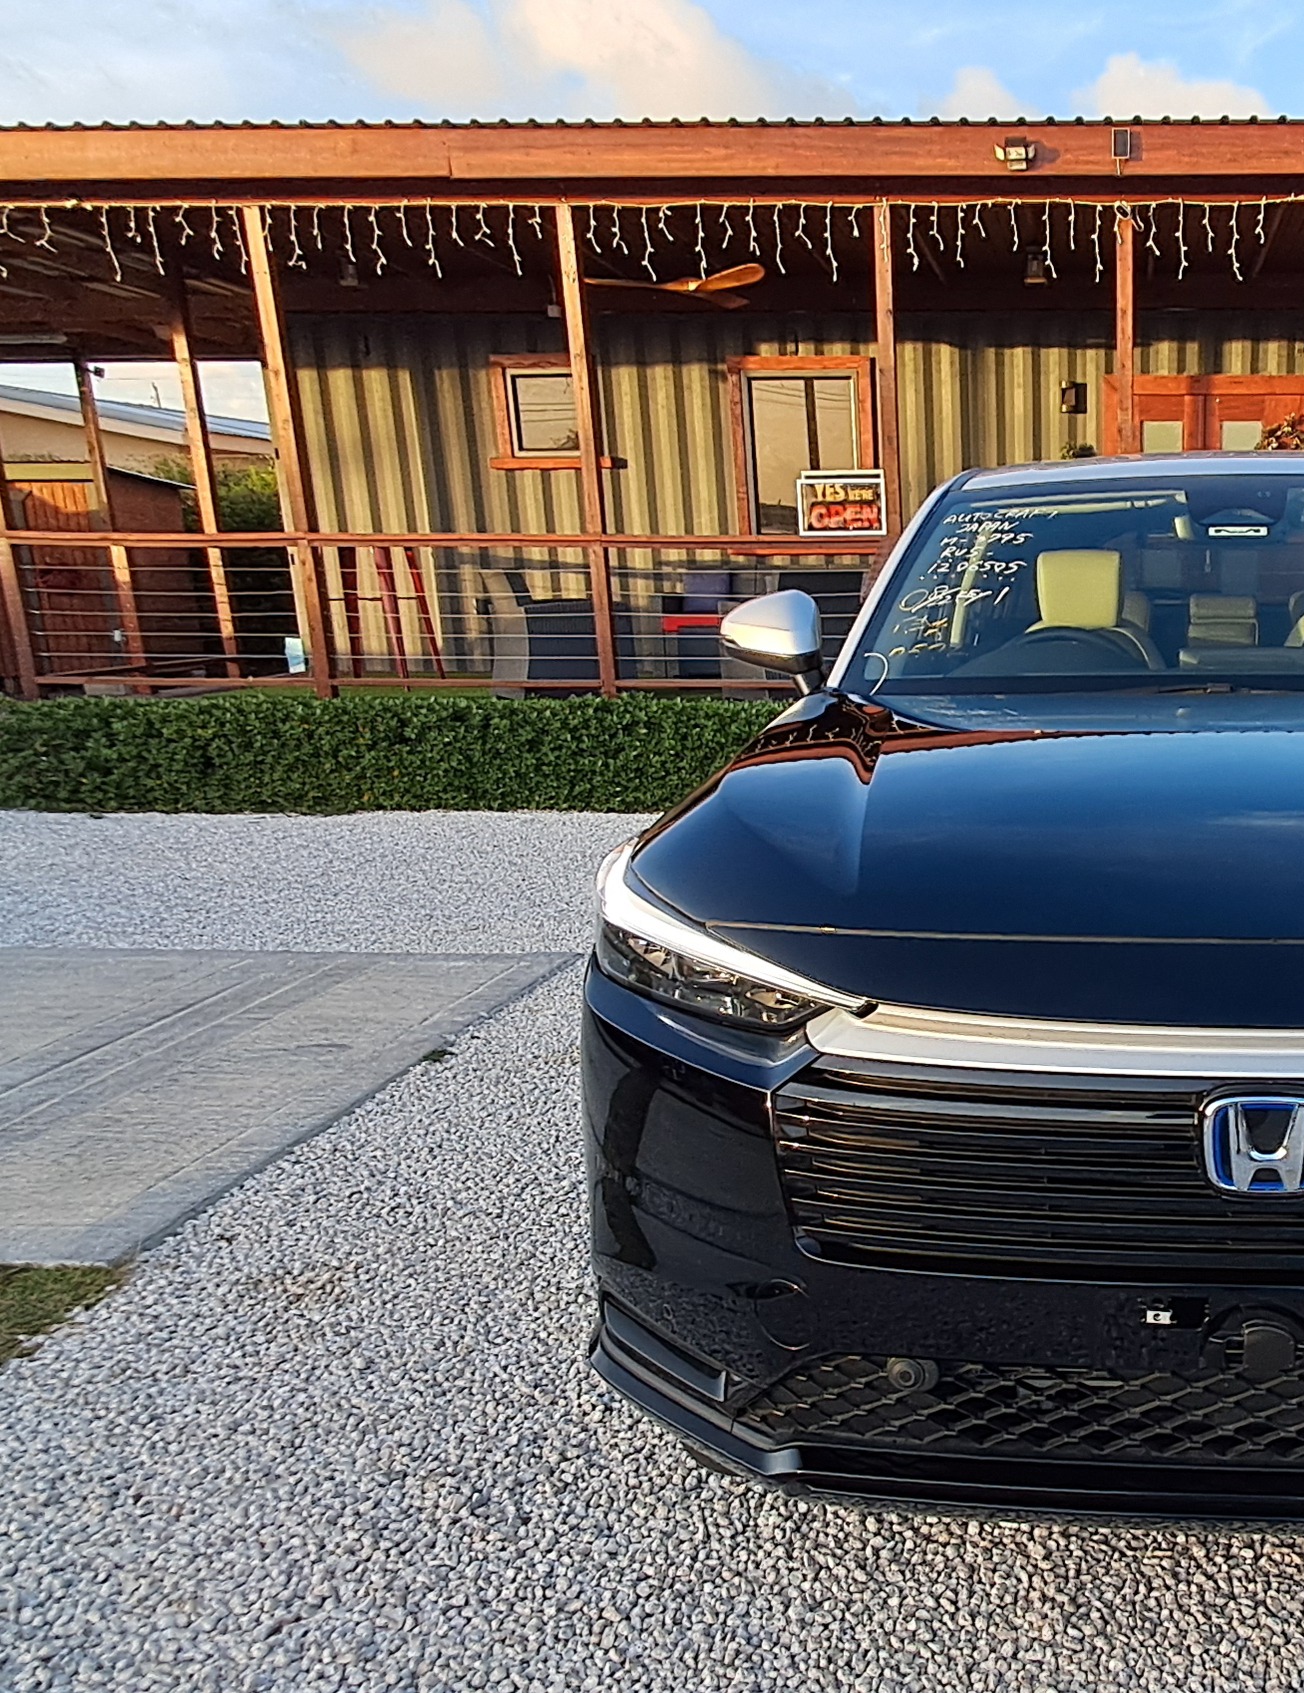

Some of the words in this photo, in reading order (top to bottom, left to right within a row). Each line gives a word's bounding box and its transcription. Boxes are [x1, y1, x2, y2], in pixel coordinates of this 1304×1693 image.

[814, 484, 846, 502] YES
[810, 504, 880, 529] OPEN
[955, 521, 1019, 534] JAPAN
